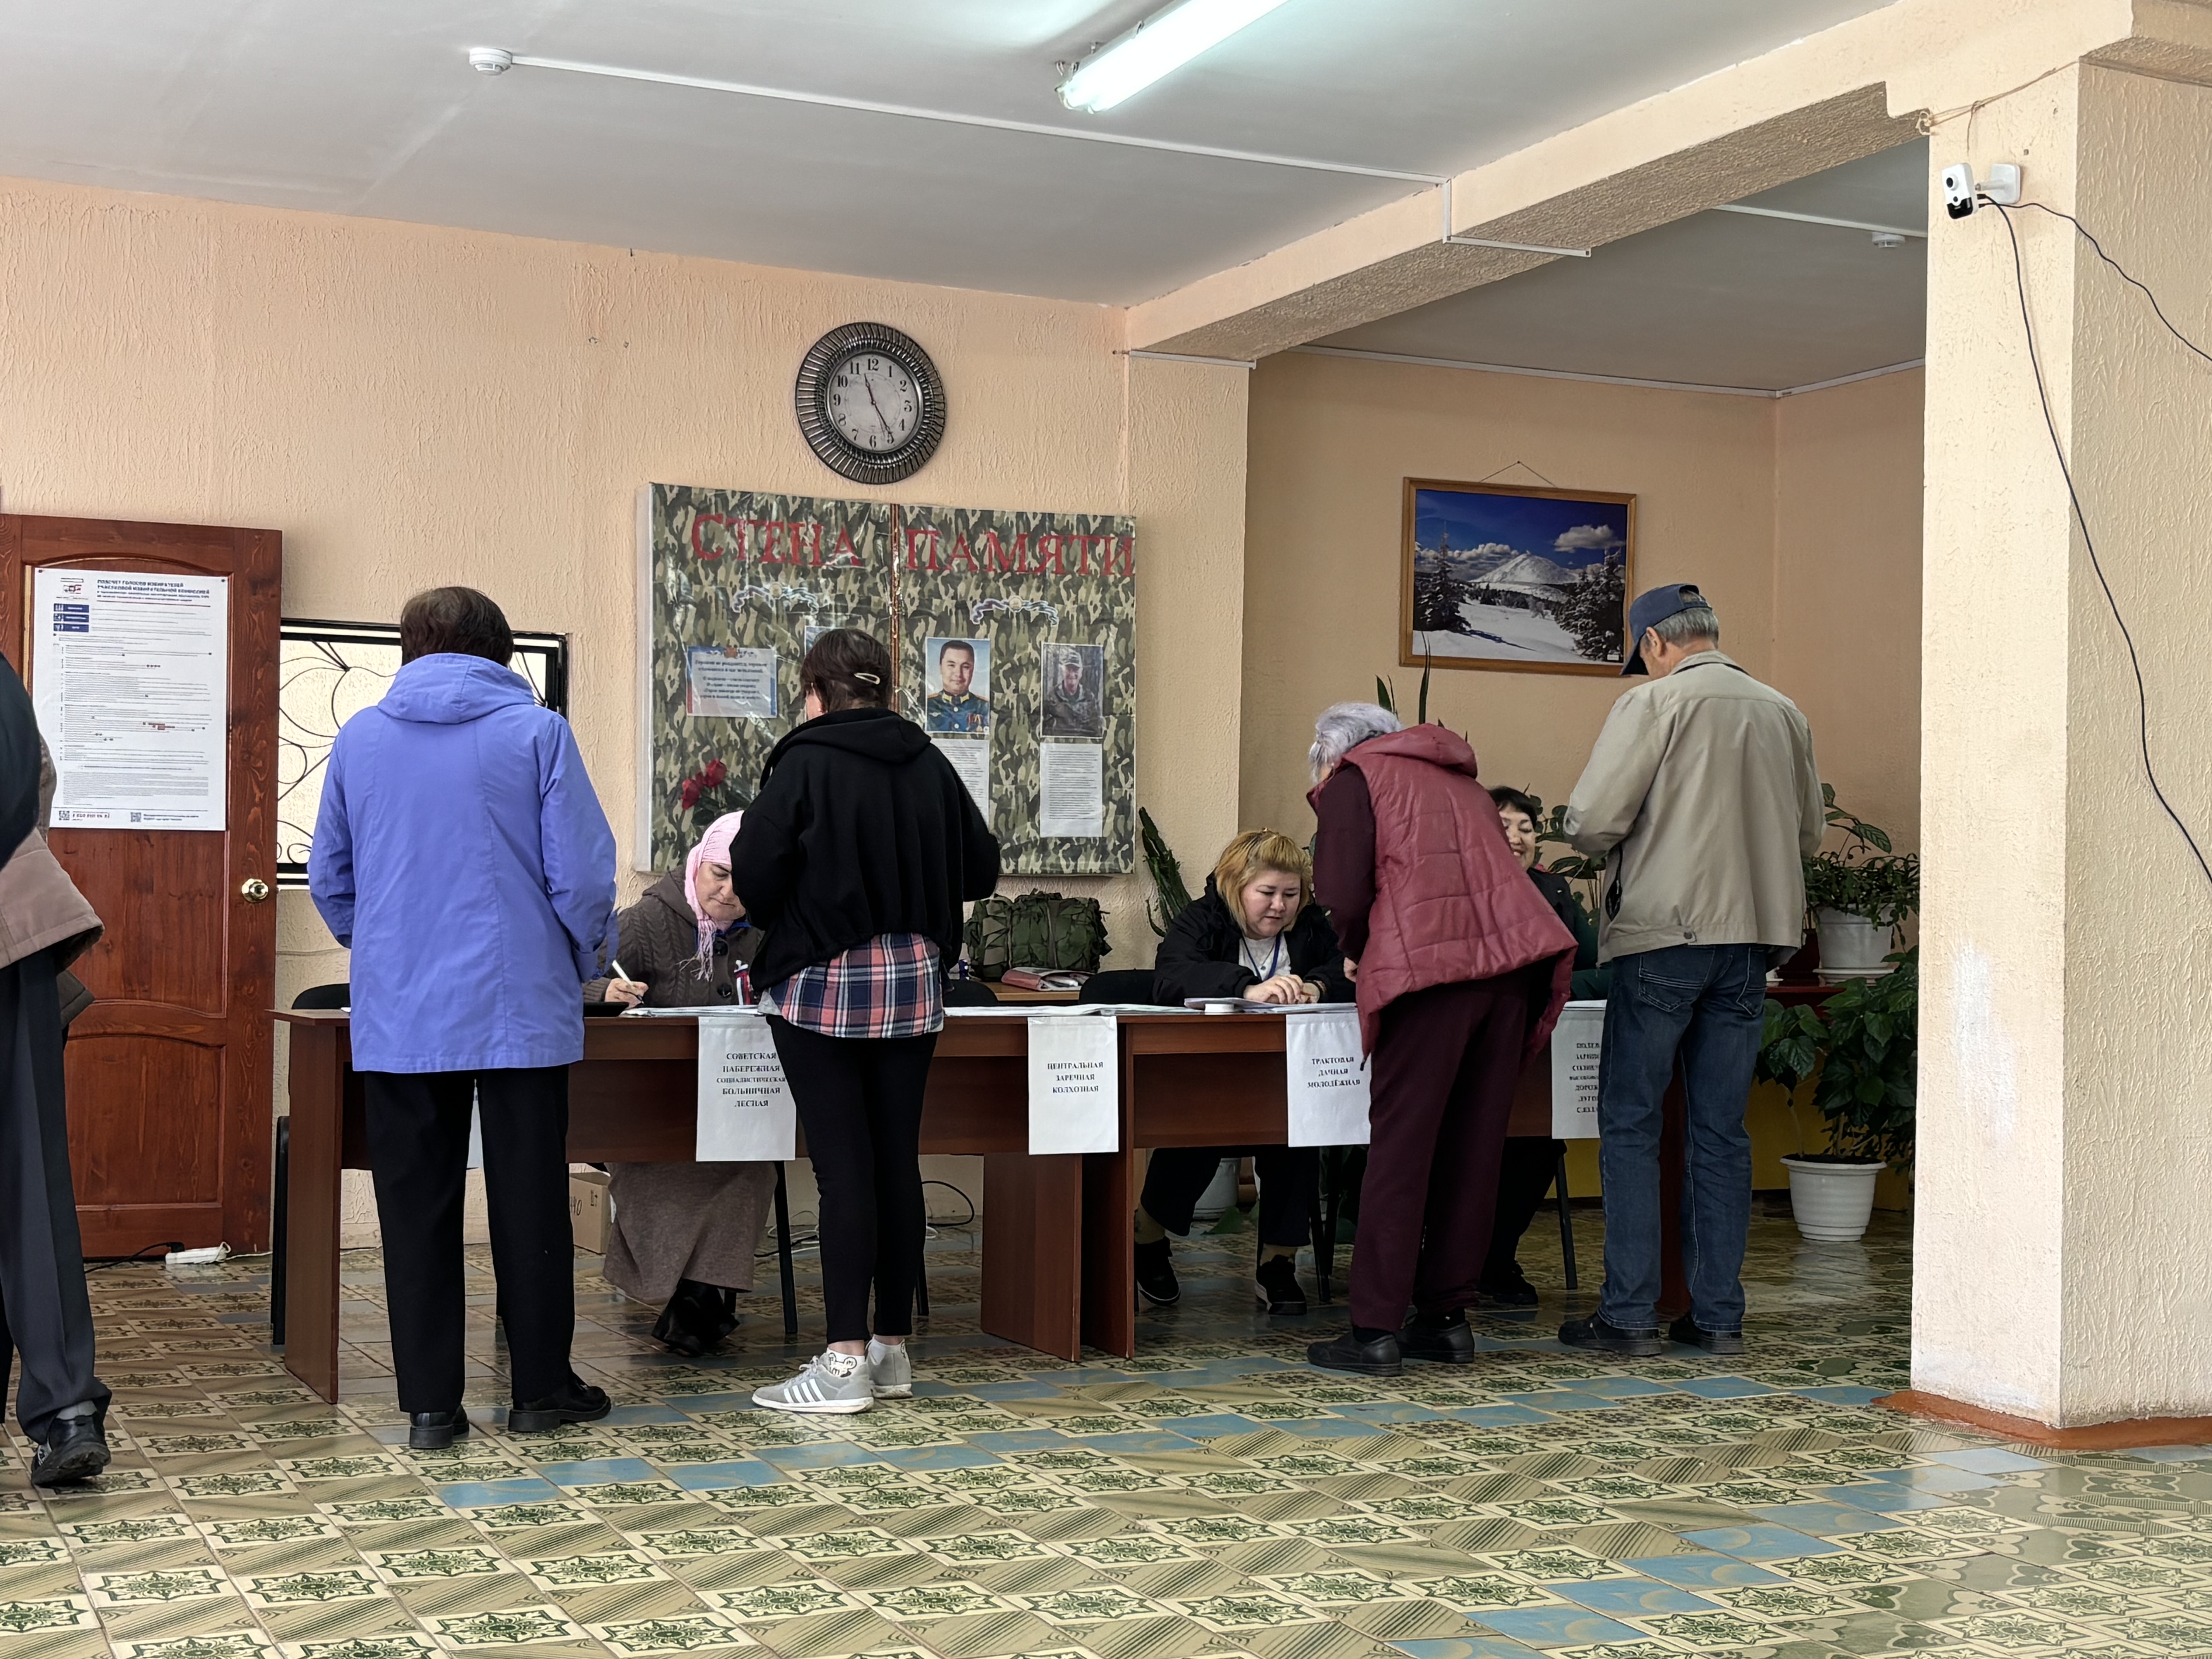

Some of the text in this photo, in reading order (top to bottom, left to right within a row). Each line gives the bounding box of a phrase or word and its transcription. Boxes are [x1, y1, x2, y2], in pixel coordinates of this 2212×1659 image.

[850, 361, 860, 374] 11
[868, 358, 879, 371] 12
[889, 366, 892, 378] 1
[837, 375, 848, 388] 10
[900, 380, 907, 392] 2
[833, 394, 841, 406] 9
[904, 400, 912, 412] 3
[838, 413, 846, 426] 8
[898, 419, 905, 431] 4
[852, 428, 859, 441] 7
[887, 431, 894, 444] 5
[869, 435, 876, 448] 6
[692, 514, 1135, 577] СТЕНА ПАМЯТИ
[1319, 1068, 1348, 1077] ДАЧНАЯ
